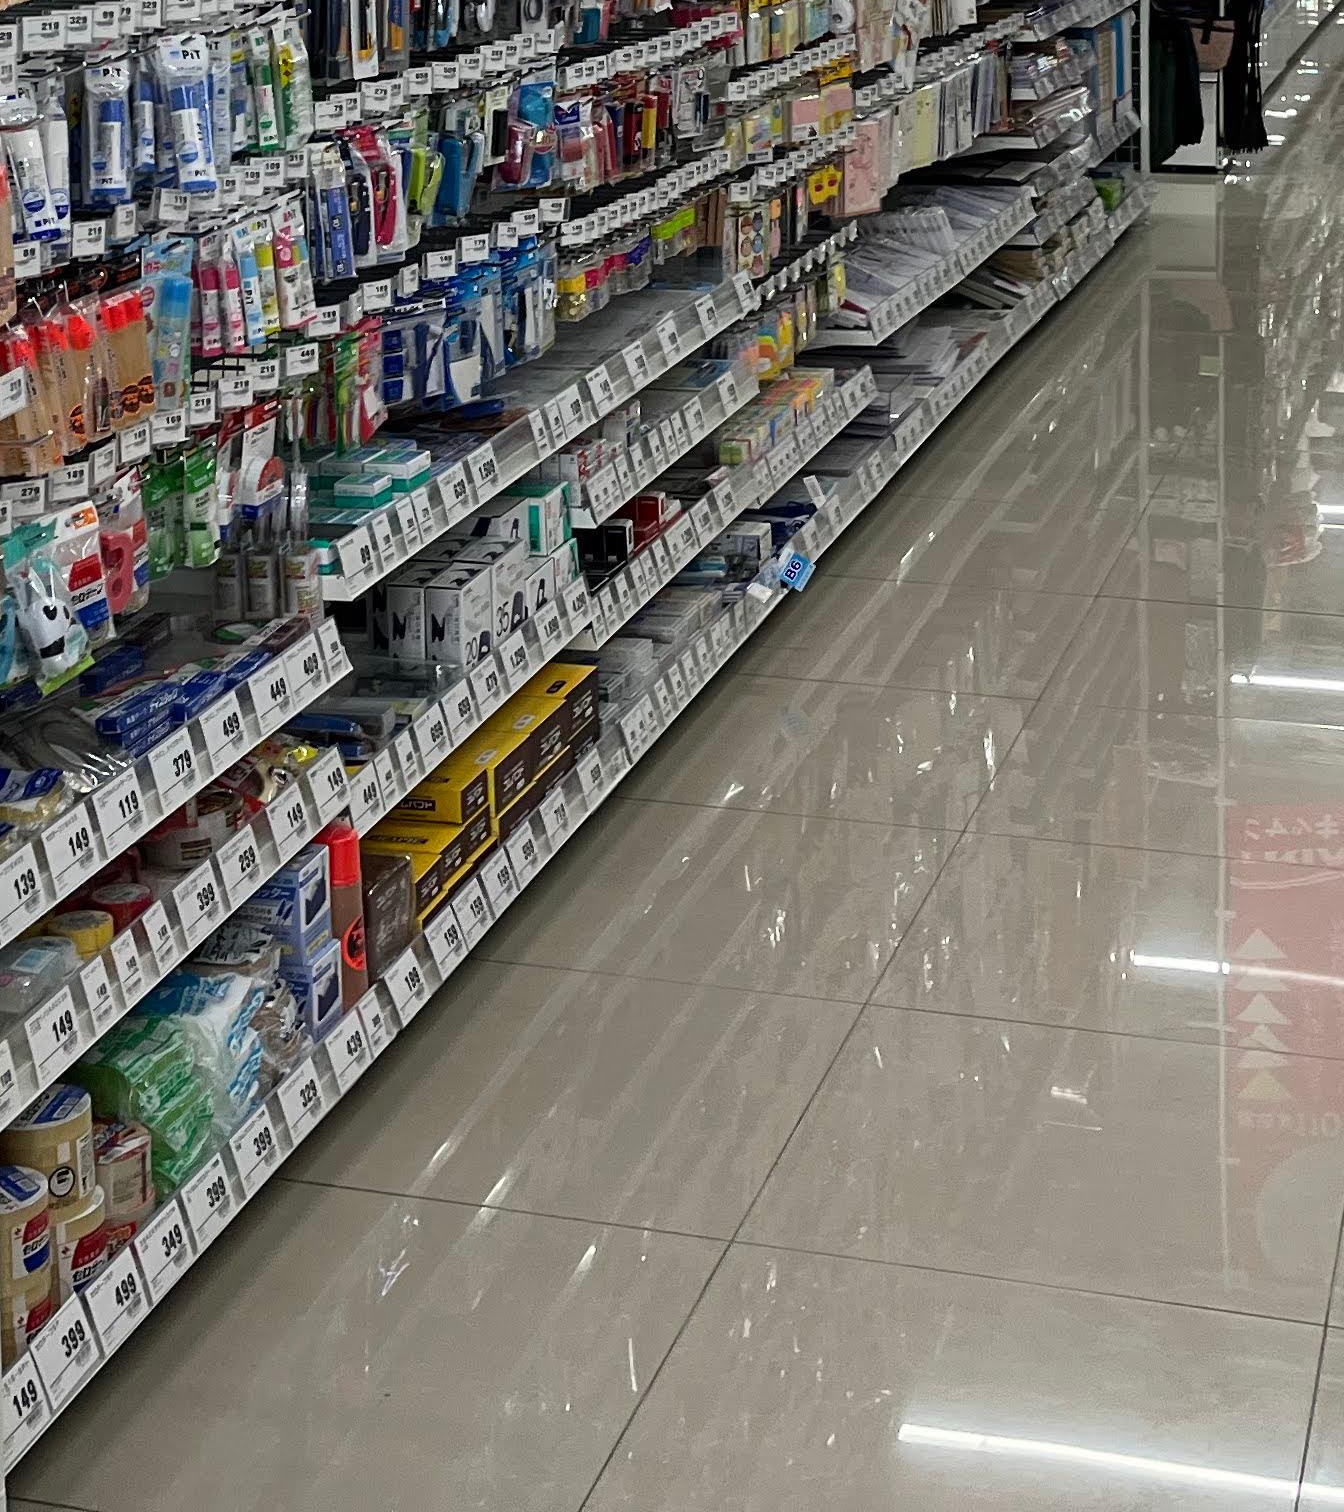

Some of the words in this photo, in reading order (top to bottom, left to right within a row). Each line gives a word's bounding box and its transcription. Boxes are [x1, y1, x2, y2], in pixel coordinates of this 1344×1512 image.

[181, 48, 201, 61] PiT
[784, 558, 803, 581] B6
[269, 678, 288, 703] 449
[222, 712, 241, 740] 499
[173, 750, 192, 779] 379
[328, 766, 345, 792] 149
[118, 794, 140, 819] 119
[287, 803, 304, 830] 149
[68, 826, 90, 857] 149
[238, 845, 256, 874] 259
[13, 868, 37, 900] 139
[196, 882, 217, 912] 399
[51, 1012, 73, 1043] 149
[252, 1126, 273, 1157] 399
[206, 1175, 227, 1208] 399
[161, 1223, 183, 1258] 349
[114, 1272, 137, 1308] 499
[60, 1319, 86, 1358] 399
[12, 1379, 39, 1418] 149
